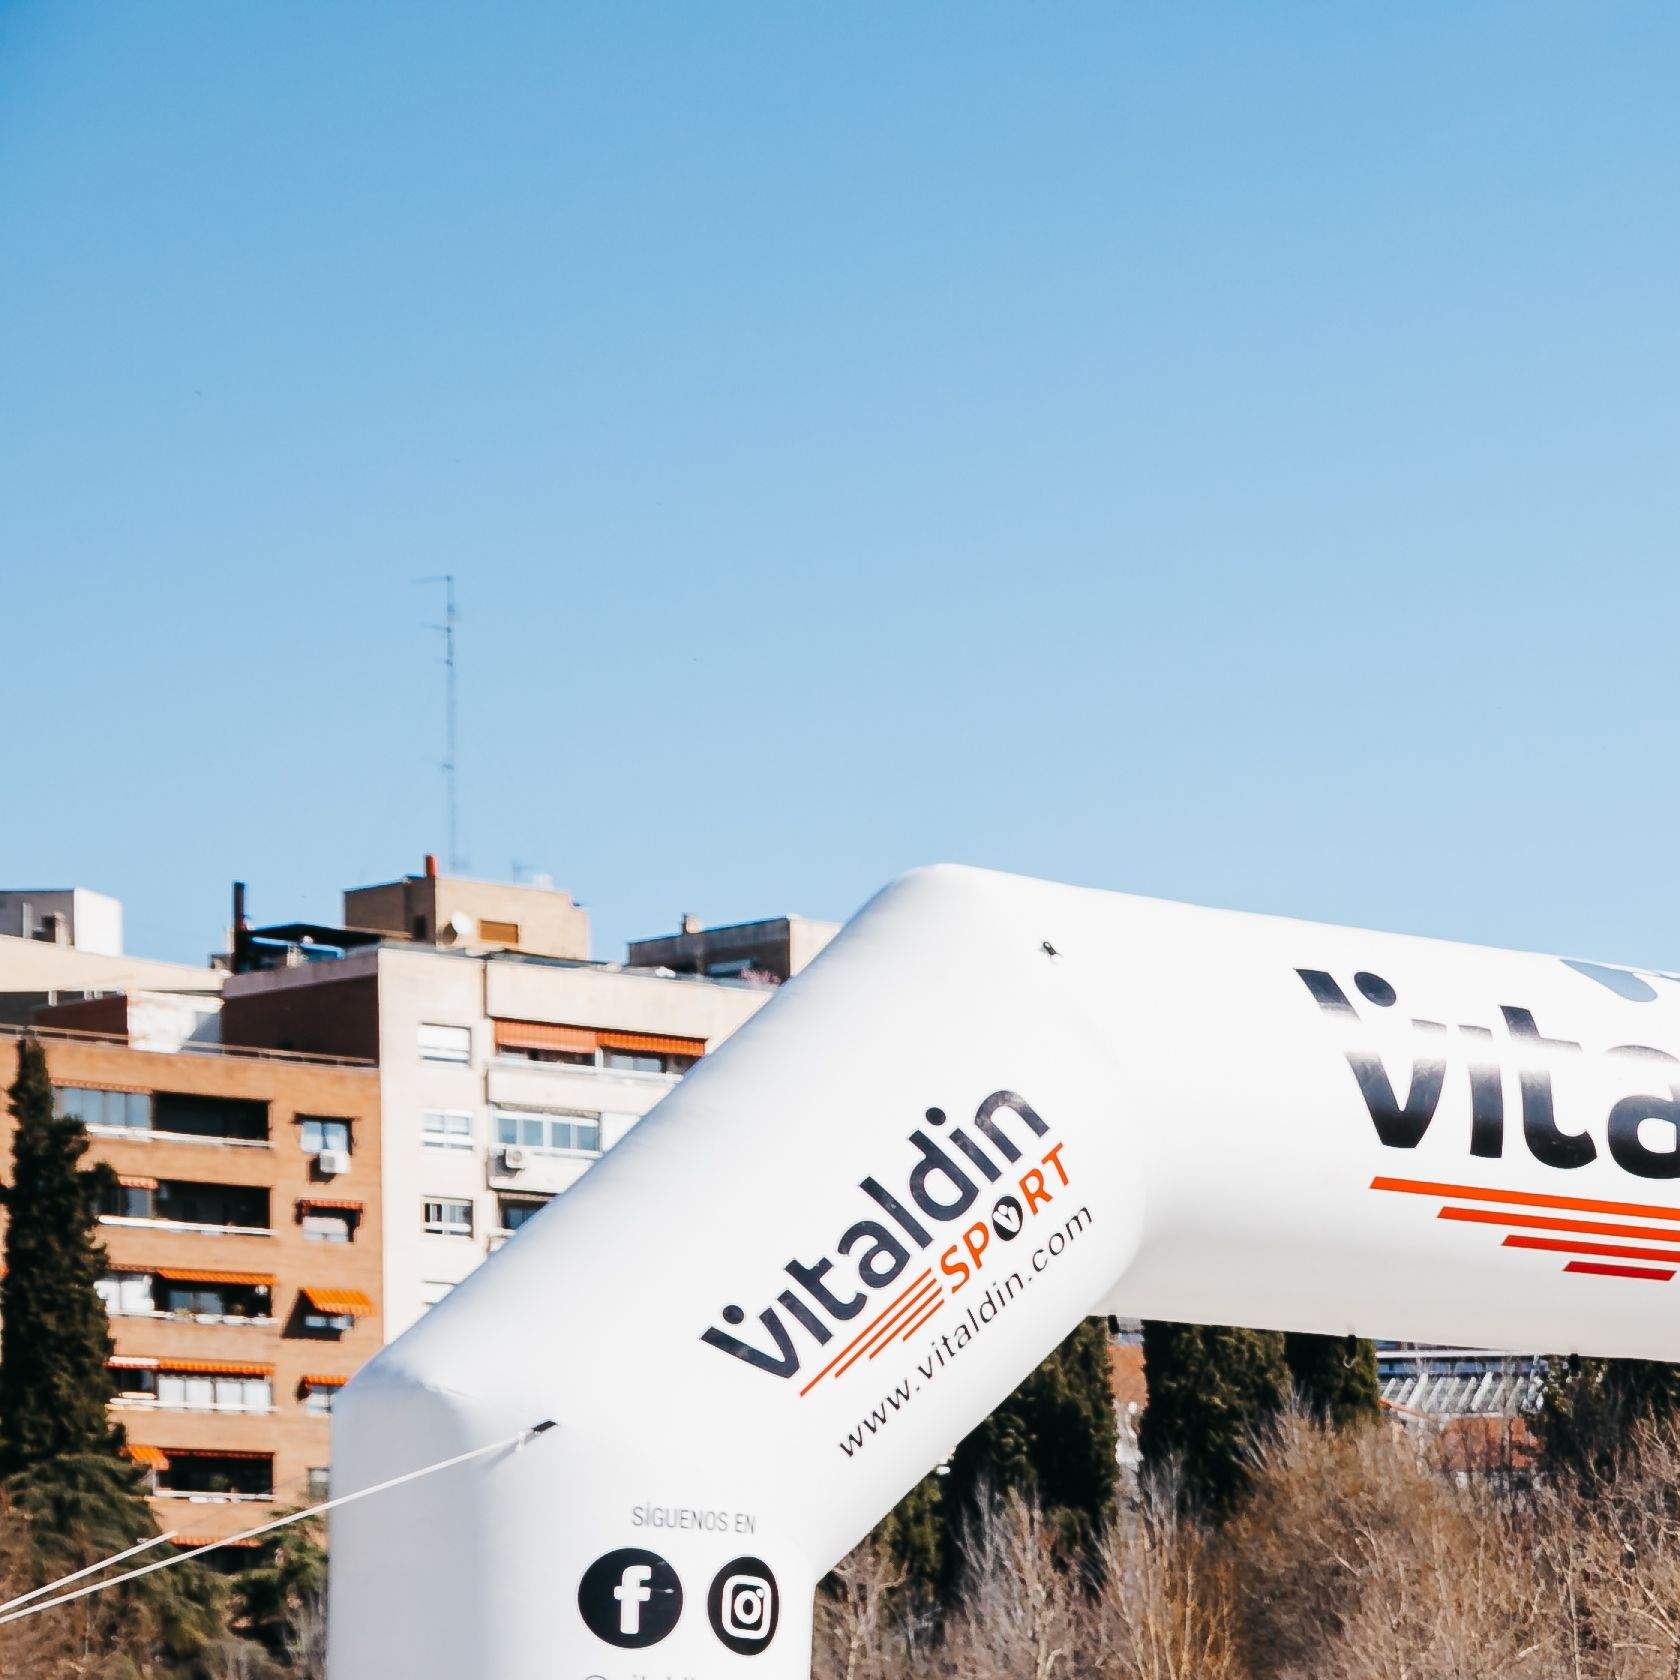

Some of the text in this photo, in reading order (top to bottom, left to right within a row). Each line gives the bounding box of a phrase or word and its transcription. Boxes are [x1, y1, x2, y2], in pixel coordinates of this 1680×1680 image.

[700, 1089, 1051, 1380] vitaldin
[939, 1142, 1070, 1295] SPORT
[838, 1203, 1094, 1459] www.vitaldin.com
[734, 1512, 756, 1534] EN
